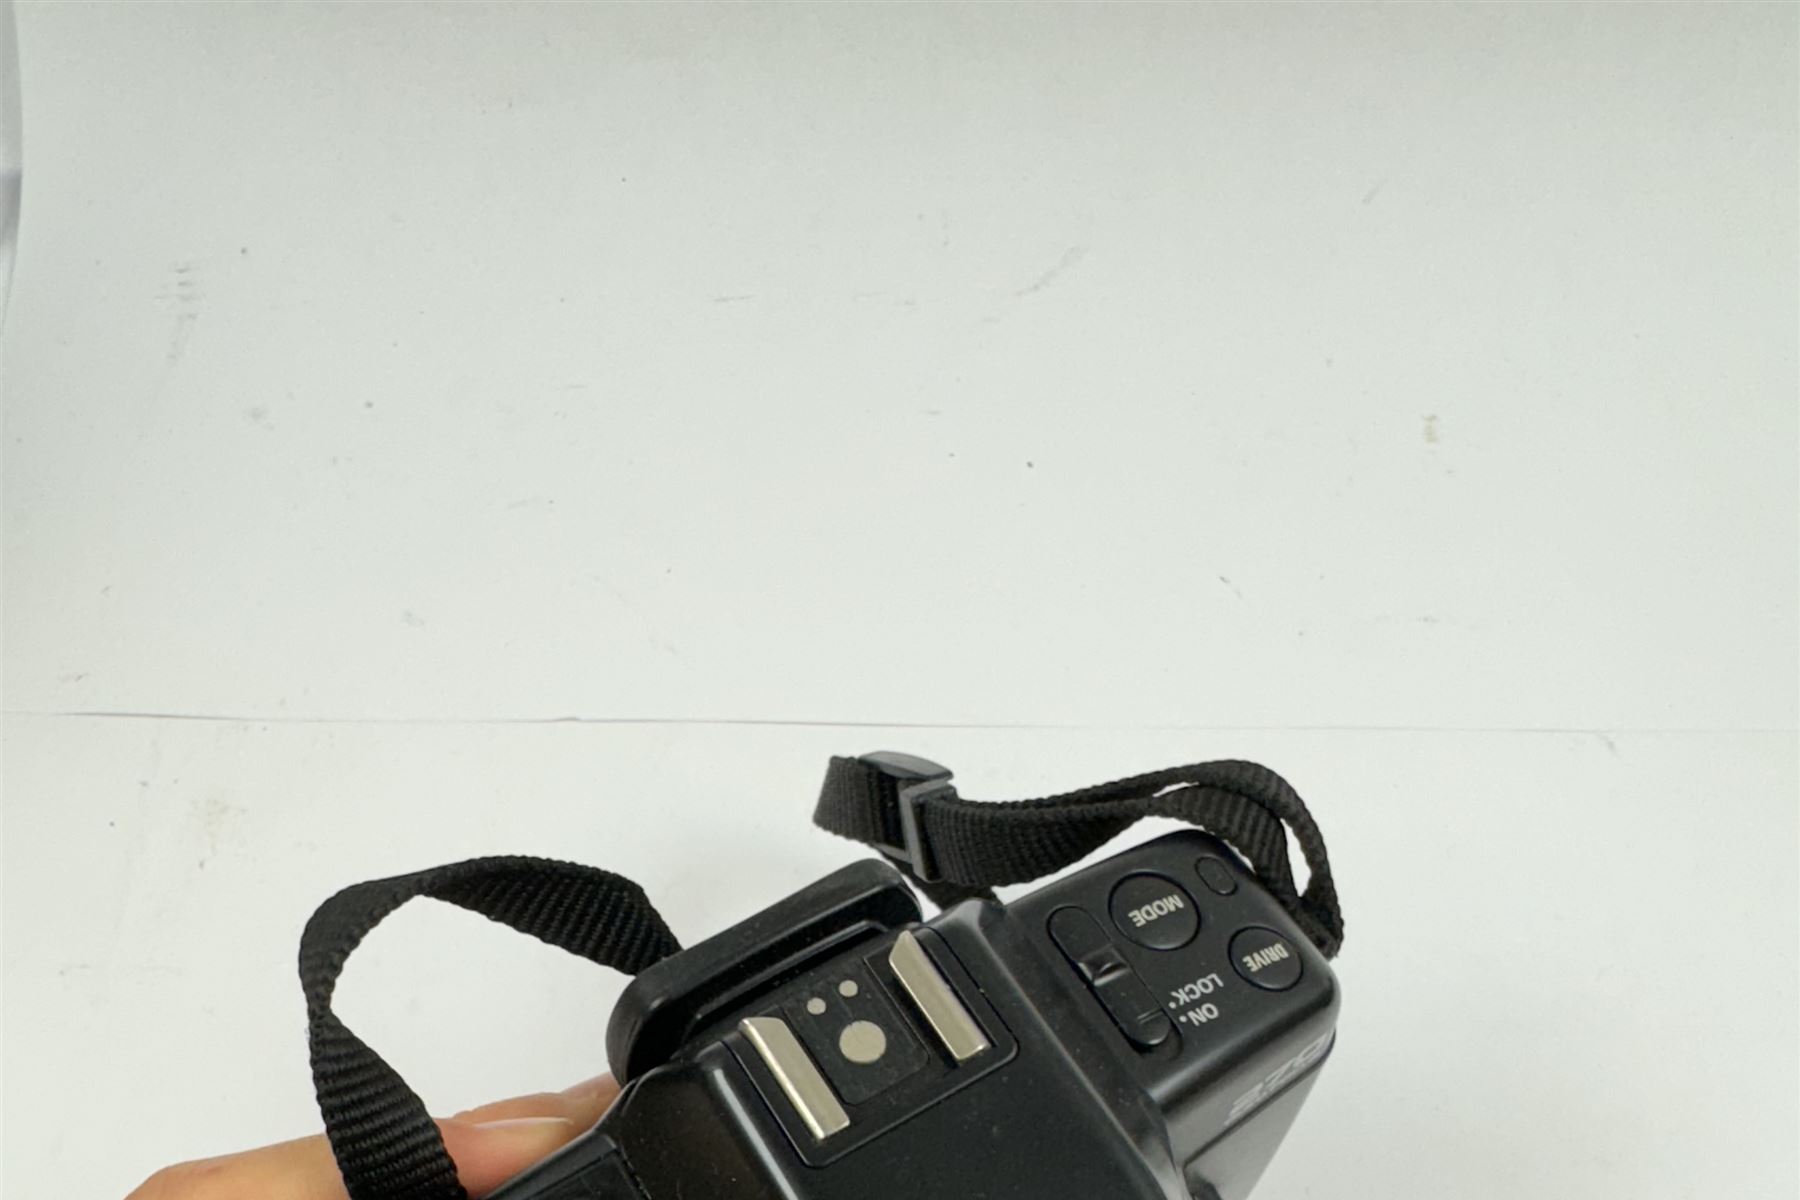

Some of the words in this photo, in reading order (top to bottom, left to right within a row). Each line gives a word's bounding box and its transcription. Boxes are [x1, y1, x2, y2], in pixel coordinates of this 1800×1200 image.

[1128, 894, 1185, 928] MODE
[1242, 943, 1290, 972] DRIVE
[1170, 972, 1225, 1006] LOCK
[1192, 1002, 1219, 1026] ON
